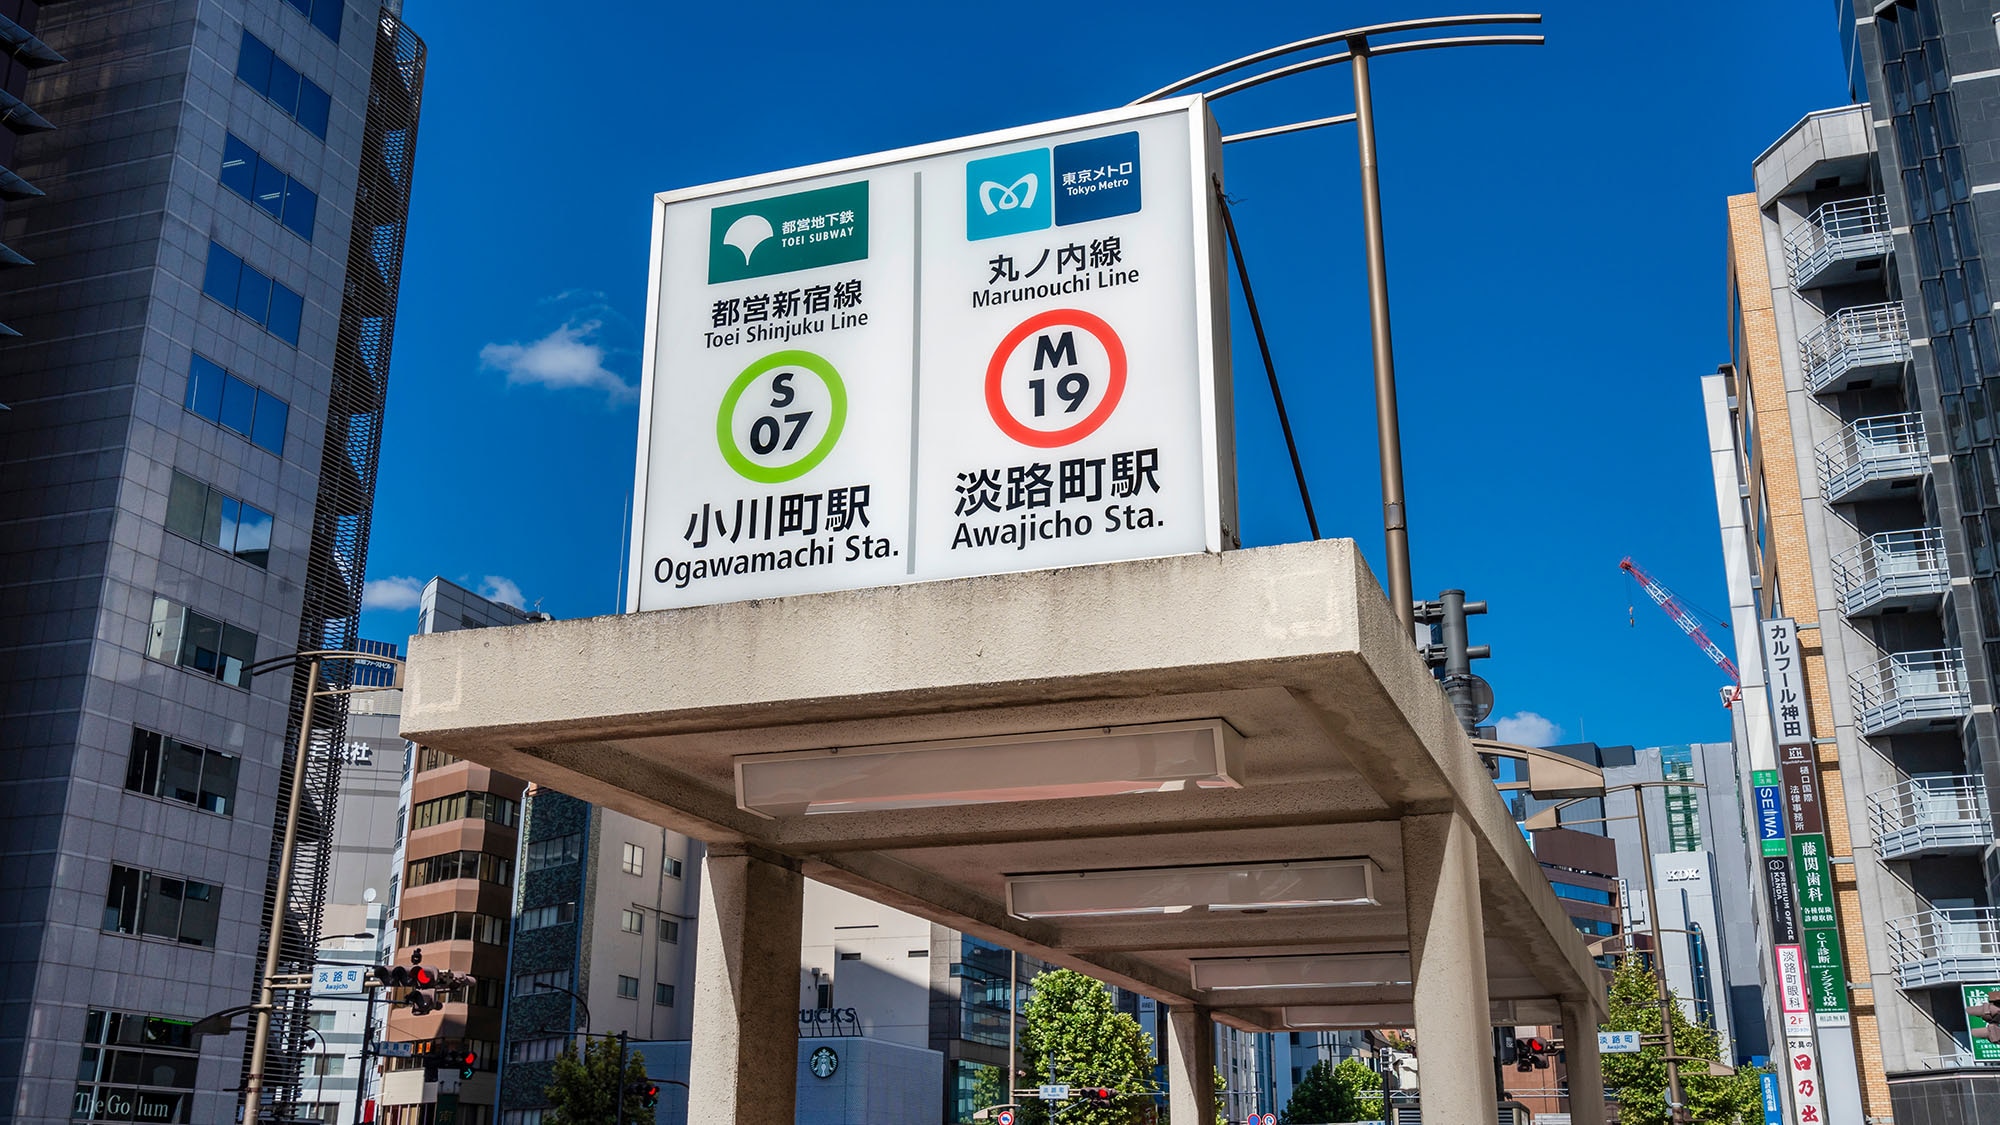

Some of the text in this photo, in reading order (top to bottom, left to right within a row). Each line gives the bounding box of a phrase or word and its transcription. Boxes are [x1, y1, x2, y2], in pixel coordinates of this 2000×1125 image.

[1062, 161, 1134, 186] 東京メトロ
[1066, 177, 1129, 197] Tokyo Metro
[781, 210, 855, 235] 都営地下鉄
[781, 226, 854, 248] TOEI SUBWAY
[989, 236, 1122, 285] 丸ノ内線
[711, 279, 863, 328] 都営新宿線
[972, 266, 1139, 309] Marunouchi Line
[704, 310, 869, 349] Toei Shinjuku Line
[1033, 331, 1078, 371] M
[770, 372, 794, 408] S
[1028, 372, 1090, 418] 19
[749, 410, 813, 455] 07
[954, 447, 1161, 517] 淡路町駅
[683, 485, 871, 549] 小川町駅
[951, 504, 1164, 551] Awajicho Sta.
[654, 533, 899, 589] Ogawamachi Sta.
[1771, 624, 1802, 738] カルフール神田
[1790, 785, 1805, 831] 法律事務所
[1666, 868, 1701, 882] KDK
[1773, 871, 1783, 901] KANDA
[1801, 841, 1824, 902] 藤関歯科
[1779, 871, 1795, 941] PREMIUM OFFICE
[318, 970, 358, 983] 淡路町
[1782, 951, 1801, 1008] 淡路町眼科
[1599, 1034, 1633, 1045] 淡路町
[1789, 1015, 1804, 1025] 2F
[1788, 1040, 1813, 1049] 文具の
